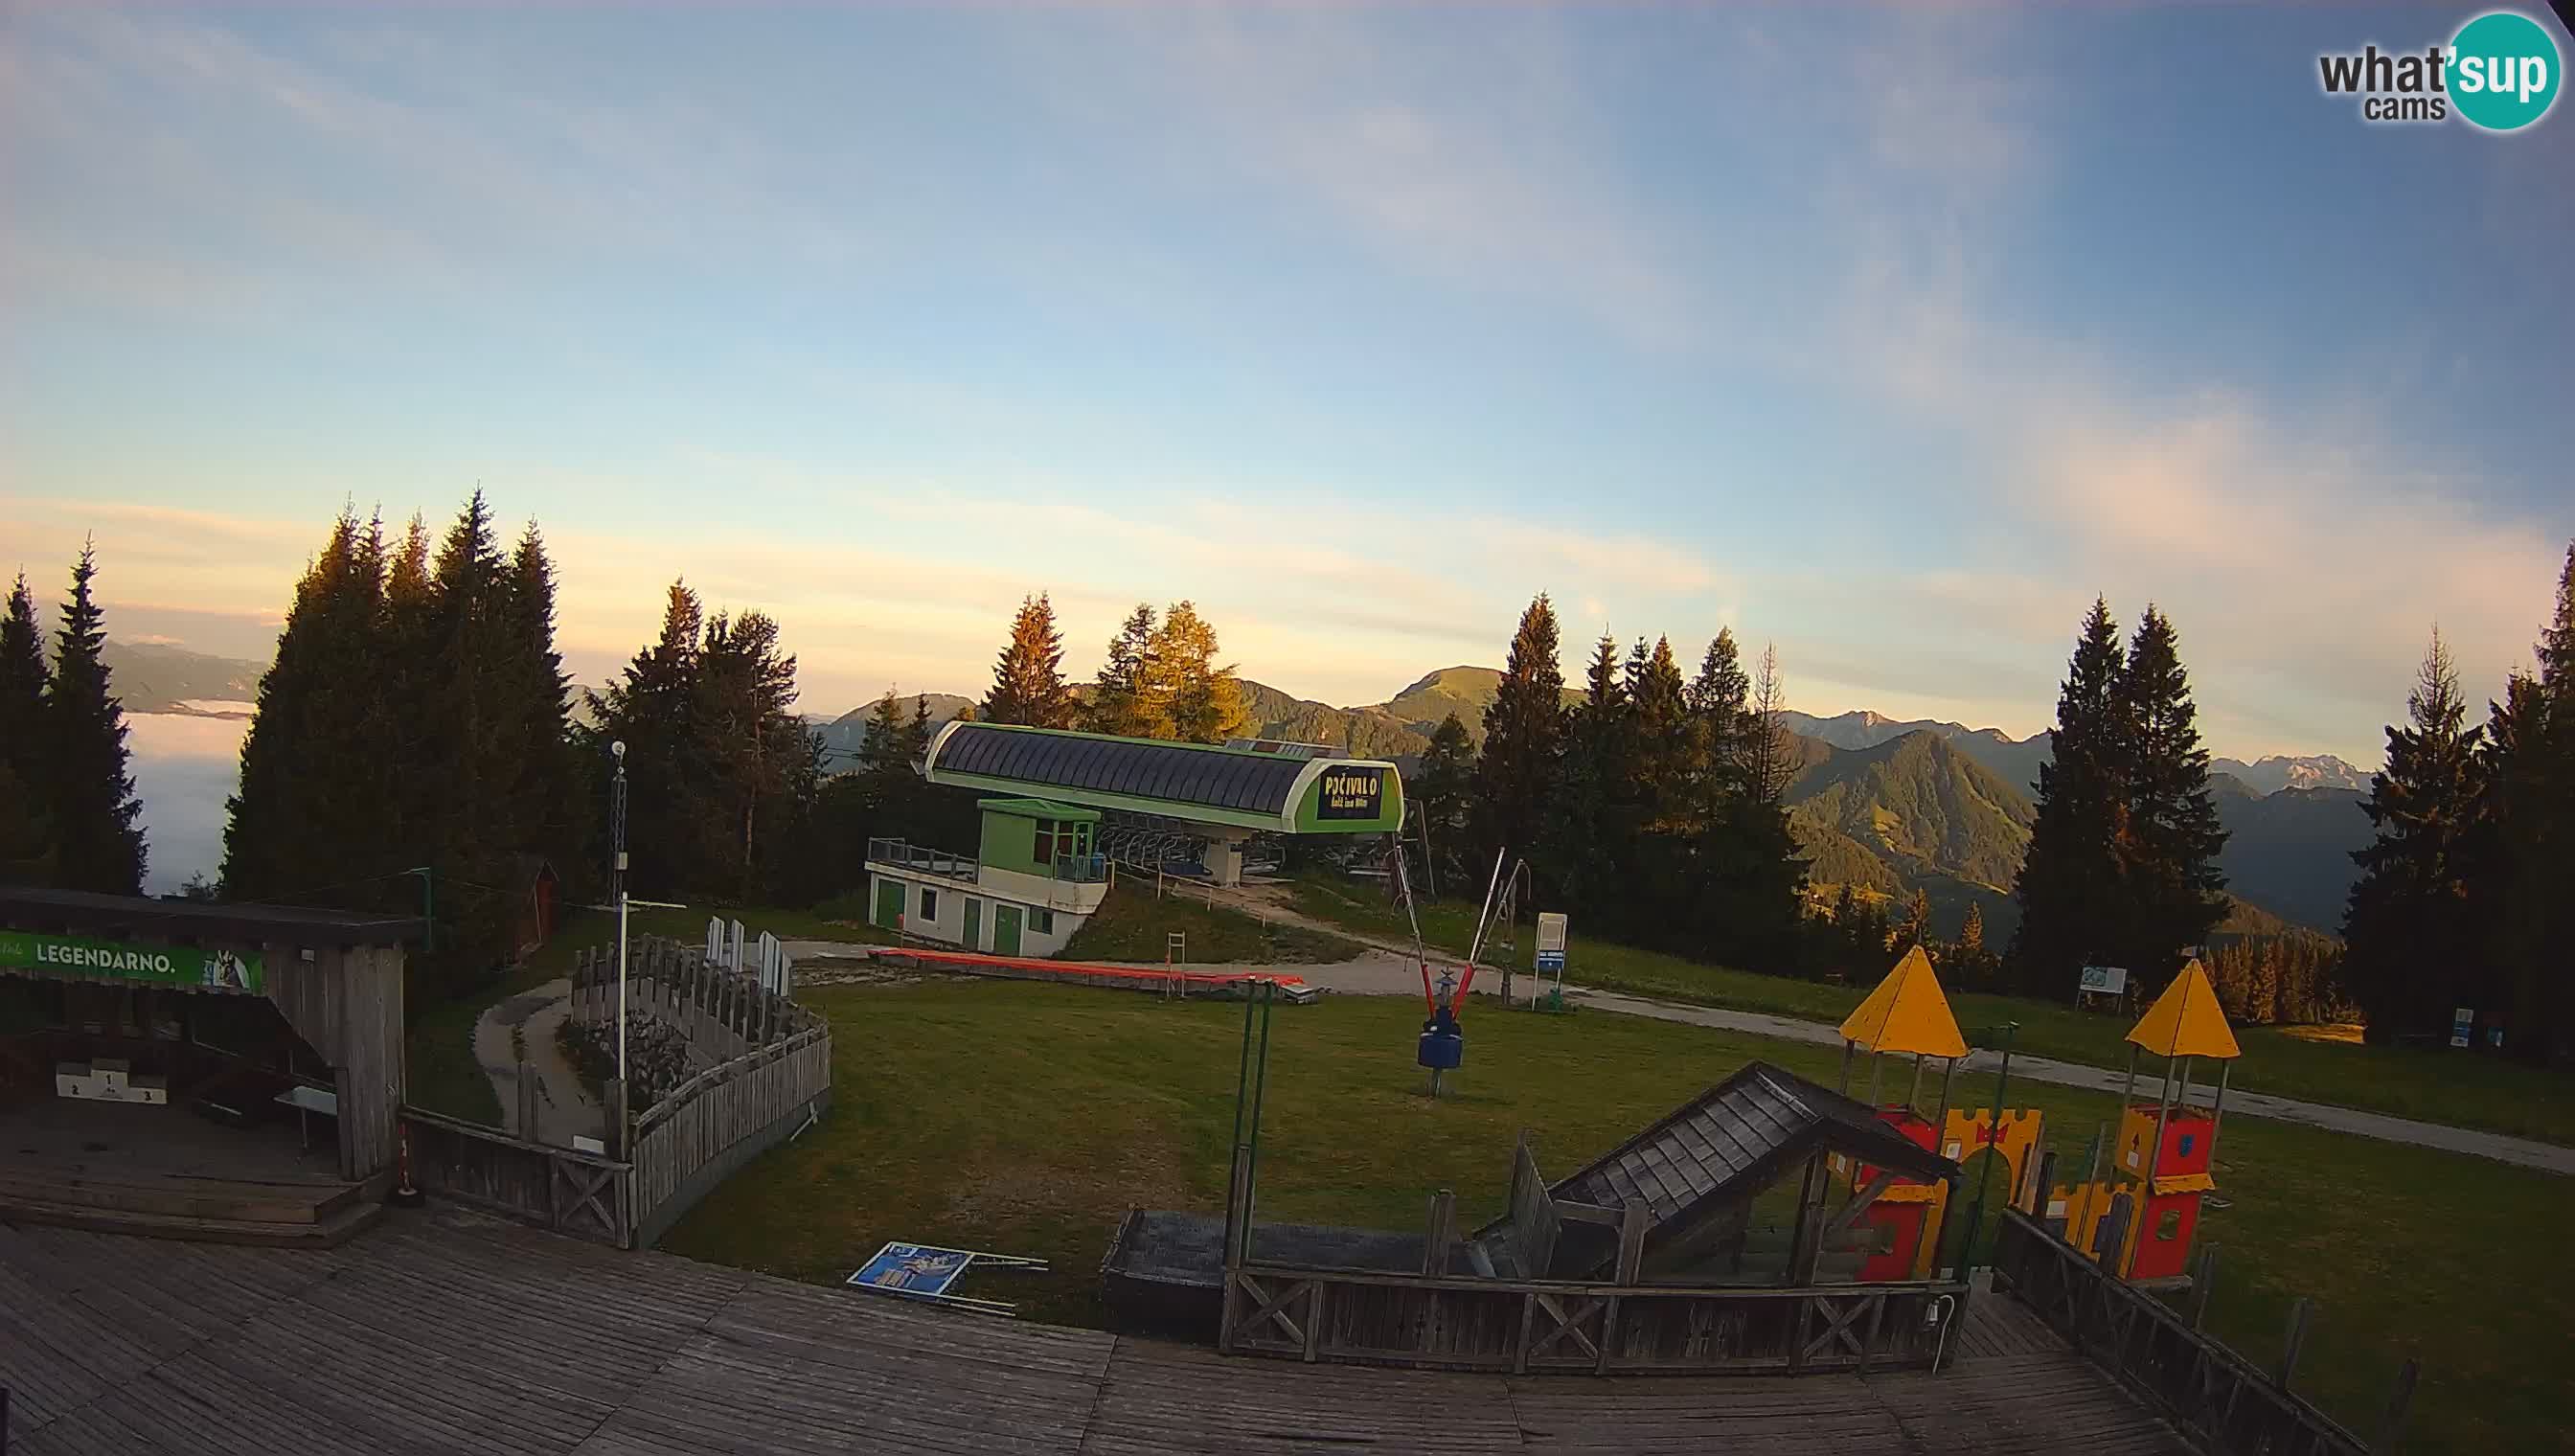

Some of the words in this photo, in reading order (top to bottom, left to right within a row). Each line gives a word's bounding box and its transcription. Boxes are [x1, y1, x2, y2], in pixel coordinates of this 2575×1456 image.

[36, 943, 176, 974] LEGENDARNO.
[106, 1075, 111, 1085] 1
[72, 1084, 79, 1095] 2
[145, 1091, 152, 1101] 3
